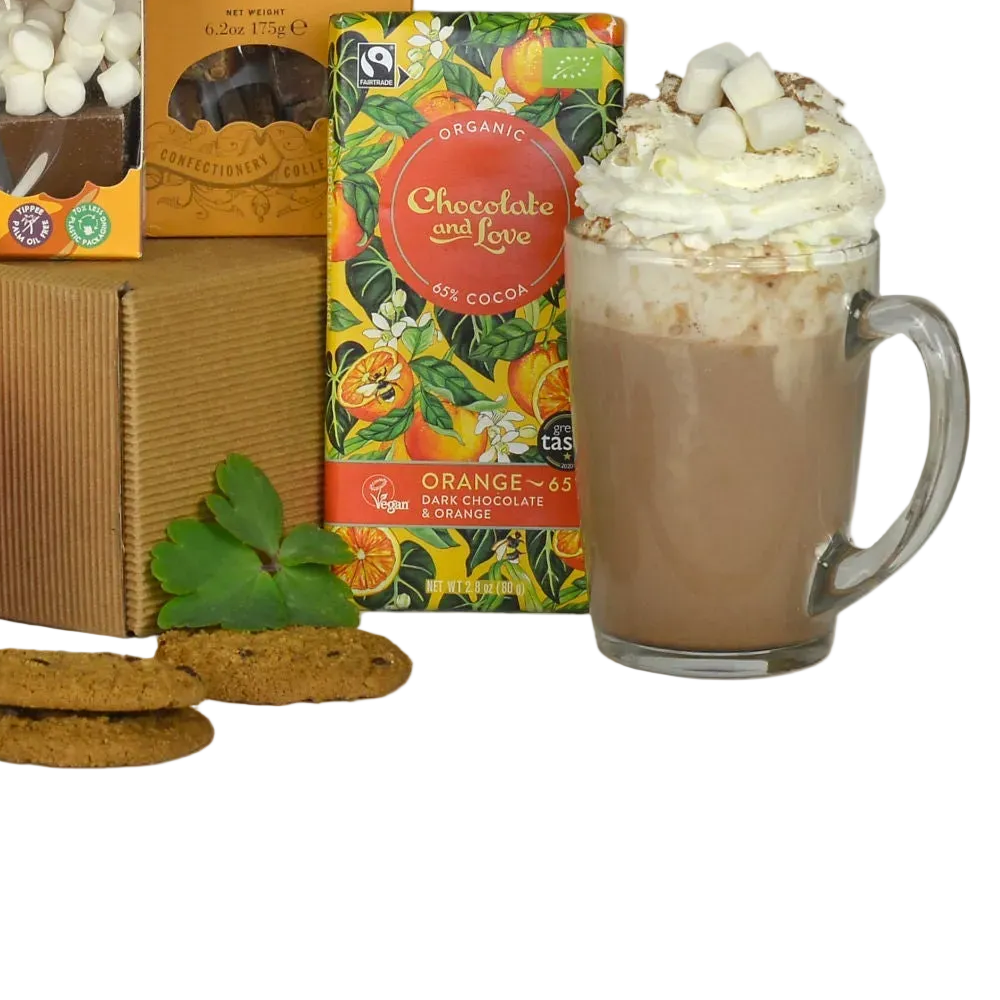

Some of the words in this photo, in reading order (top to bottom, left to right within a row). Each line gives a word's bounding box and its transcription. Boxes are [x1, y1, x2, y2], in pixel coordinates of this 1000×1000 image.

[248, 8, 286, 16] WEIGHT
[205, 22, 245, 36] 6.2oz
[251, 22, 286, 39] 175g
[439, 121, 526, 141] ORGANIC
[160, 149, 268, 177] CONFECTIONERY
[284, 159, 326, 178] COLLE
[72, 205, 88, 216] 70%
[88, 204, 104, 216] LESS
[407, 186, 554, 216] Chocolate
[16, 205, 45, 216] YIPPEE
[12, 220, 25, 243] PALM
[26, 237, 41, 246] OIL
[40, 219, 50, 239] FREE
[68, 216, 82, 243] PLASTIC
[82, 216, 109, 246] PACKAGING
[431, 218, 472, 240] and
[474, 217, 531, 255] Love
[432, 283, 459, 302] 65%
[466, 284, 529, 305] COCOA
[553, 424, 571, 436] gre
[541, 434, 573, 451] tas
[422, 472, 523, 491] ORANGE
[549, 477, 577, 492] 65
[370, 492, 409, 514] Vegan
[421, 495, 458, 505] DARK
[462, 496, 544, 507] CHOCOLATE
[421, 509, 430, 519] &
[434, 509, 491, 519] ORANGE
[426, 579, 443, 594] NET
[447, 580, 464, 593] WT
[465, 580, 481, 593] 2.8
[484, 583, 493, 593] oz
